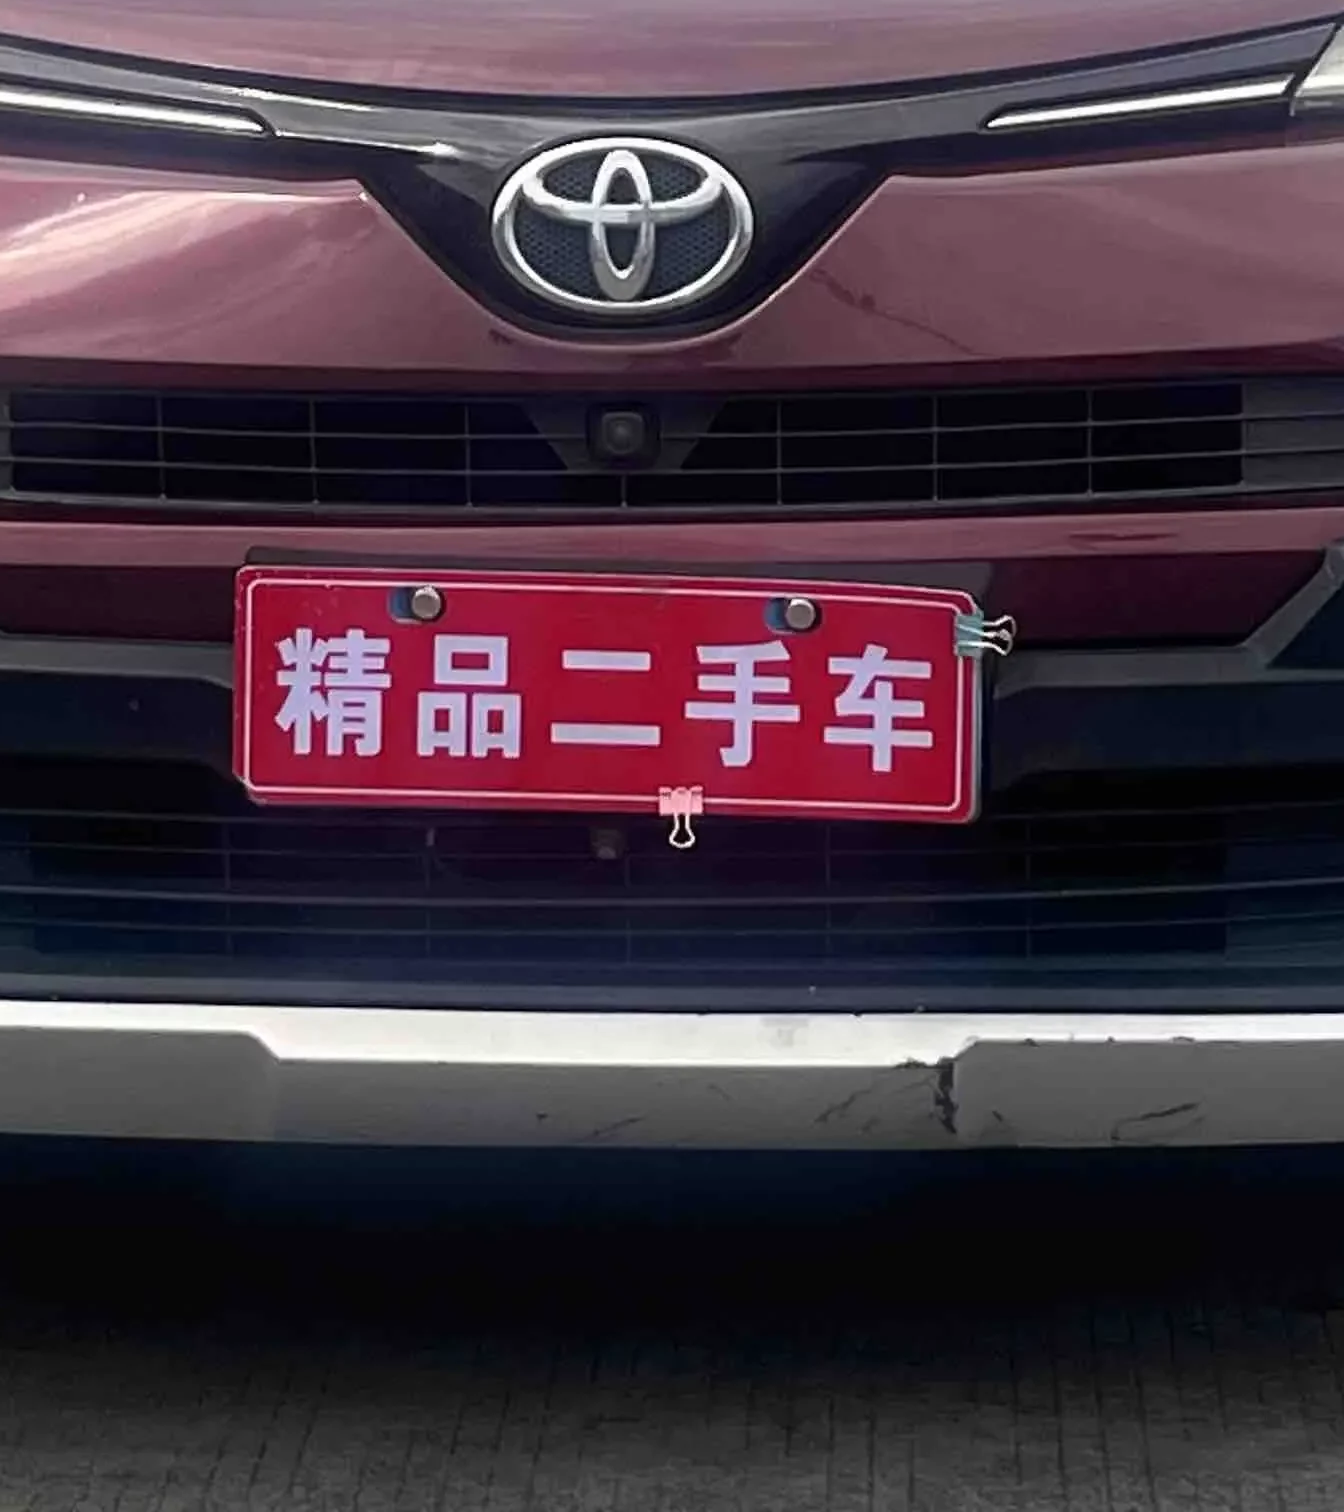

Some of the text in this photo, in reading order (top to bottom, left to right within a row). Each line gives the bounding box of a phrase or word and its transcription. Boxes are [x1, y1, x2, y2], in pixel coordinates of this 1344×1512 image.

[274, 627, 935, 773] 精品二手车
